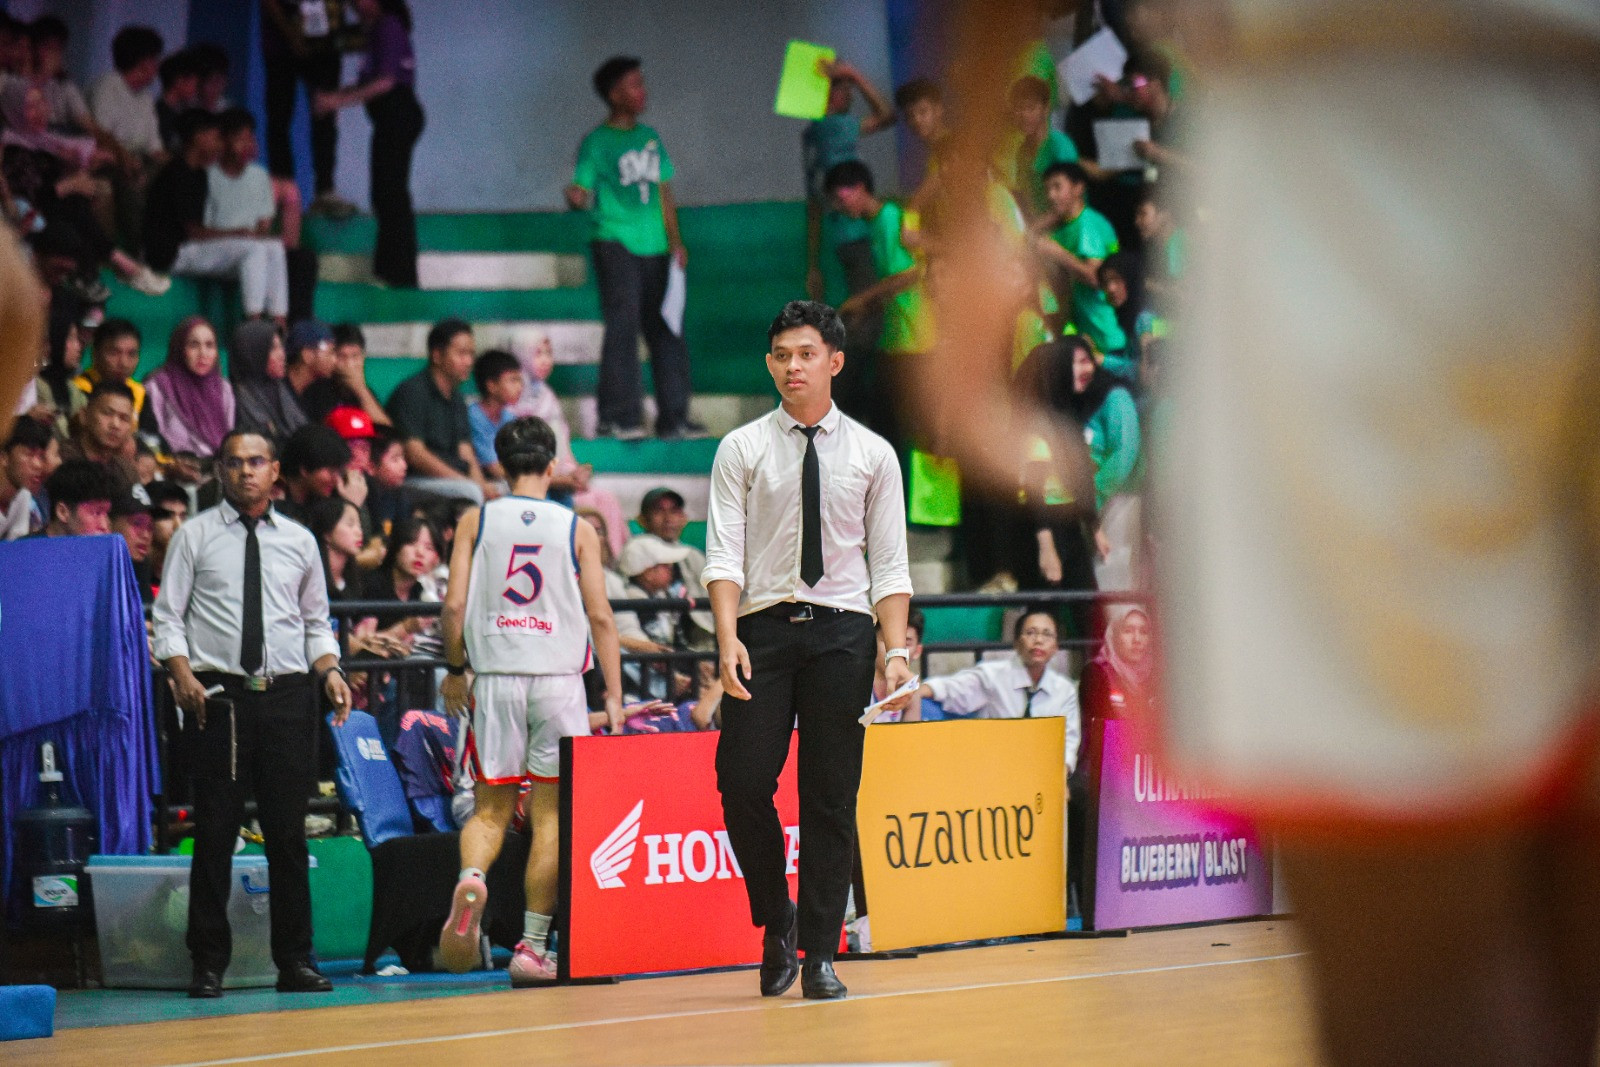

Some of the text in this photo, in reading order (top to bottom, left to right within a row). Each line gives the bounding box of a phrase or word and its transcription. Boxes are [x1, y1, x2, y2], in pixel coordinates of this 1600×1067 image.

[502, 544, 544, 607] 5
[496, 615, 527, 628] Good
[529, 616, 552, 634] Day
[643, 825, 799, 885] HON
[1121, 838, 1247, 884] BLUEBERRY BLAST
